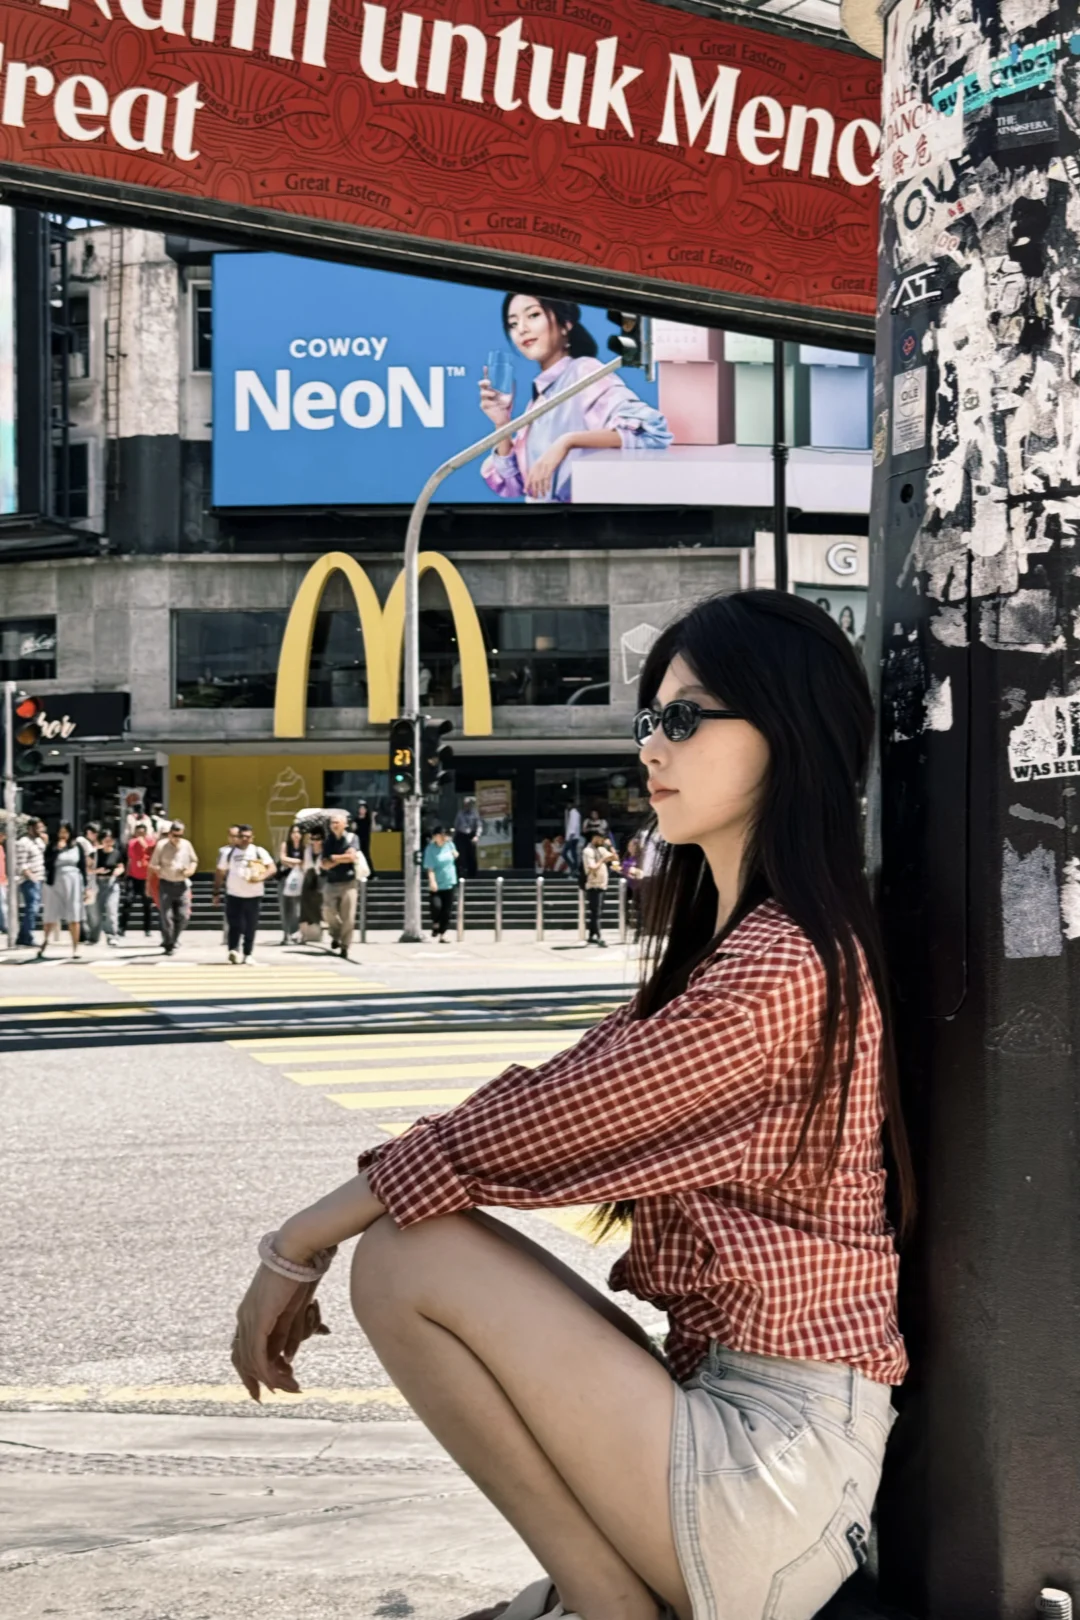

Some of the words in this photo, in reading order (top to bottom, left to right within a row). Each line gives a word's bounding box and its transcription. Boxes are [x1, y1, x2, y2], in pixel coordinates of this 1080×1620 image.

[360, 3, 643, 138] untuk
[700, 39, 738, 60] Great
[741, 45, 787, 74] Eastern
[0, 42, 205, 161] reat
[995, 113, 1018, 127] THE
[285, 173, 330, 194] Great
[336, 174, 392, 209] Eastern
[487, 212, 527, 229] Great
[532, 216, 583, 245] Eastern
[667, 246, 707, 262] Great
[709, 248, 754, 276] Eastern
[831, 275, 866, 291] Great
[289, 337, 389, 361] coway
[235, 366, 445, 432] NeoN
[826, 542, 858, 576] G
[1013, 762, 1051, 778] WAS
